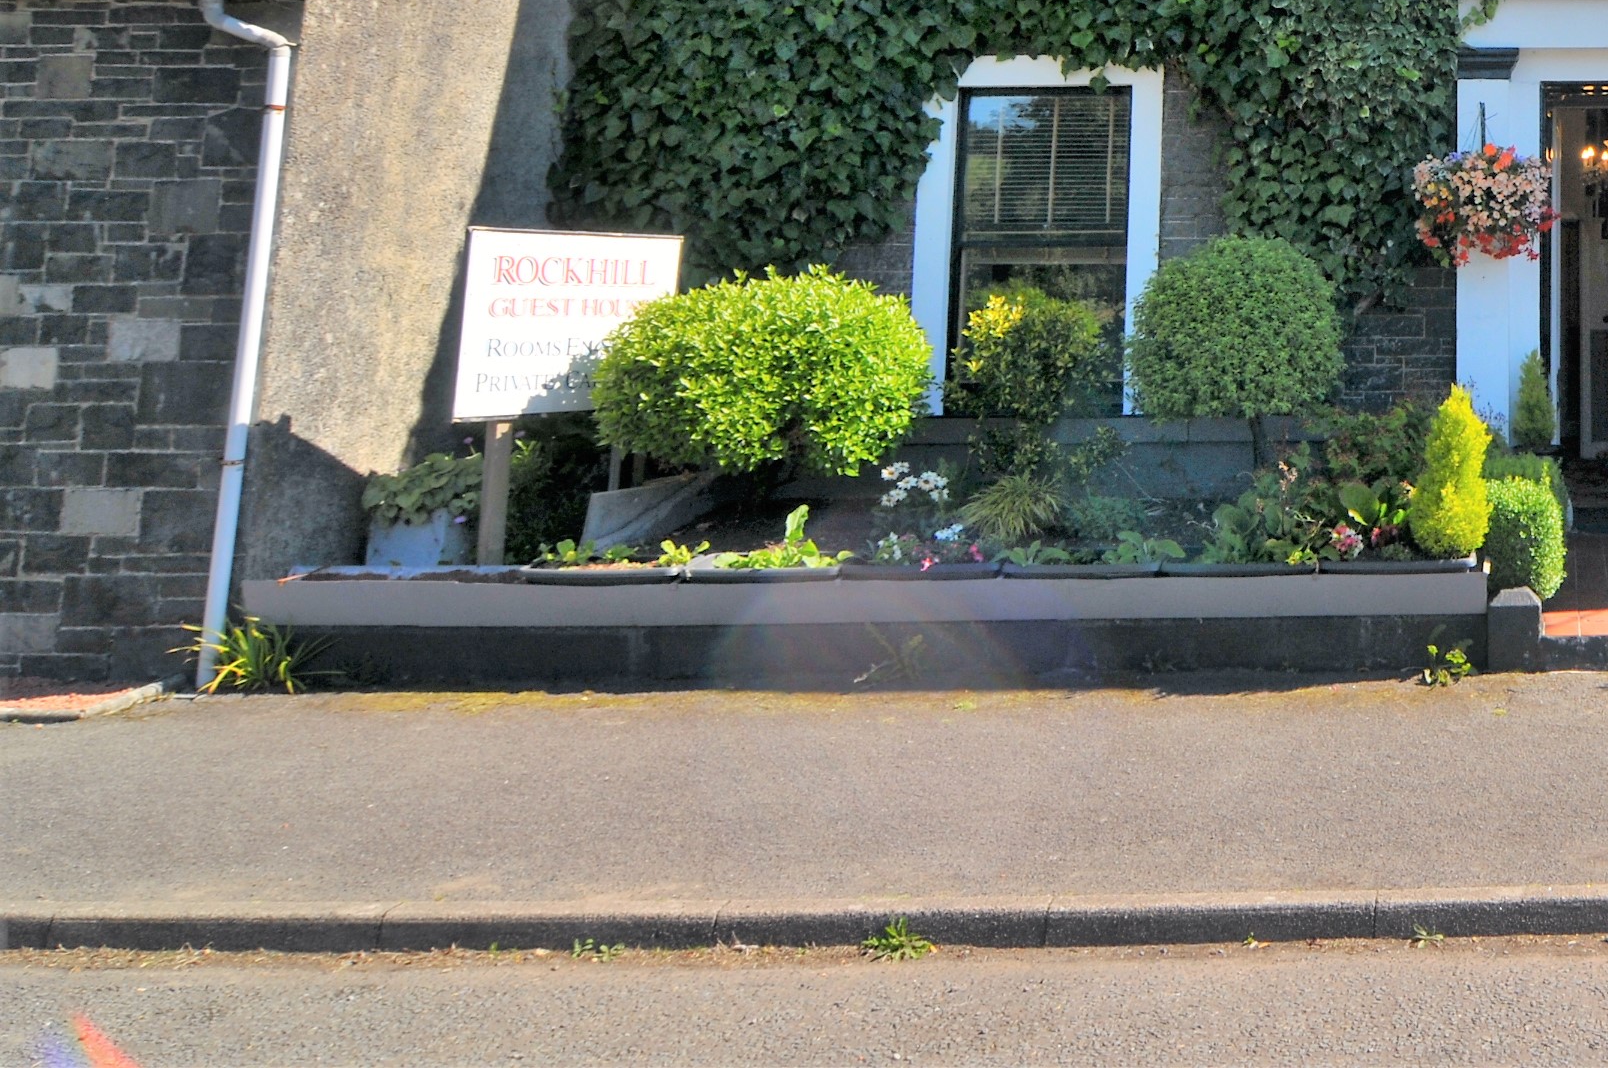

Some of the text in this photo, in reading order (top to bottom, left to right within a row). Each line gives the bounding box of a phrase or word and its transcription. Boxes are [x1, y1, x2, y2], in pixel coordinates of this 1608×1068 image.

[492, 255, 655, 287] ROCKHILL
[488, 297, 647, 317] GUEST HOU
